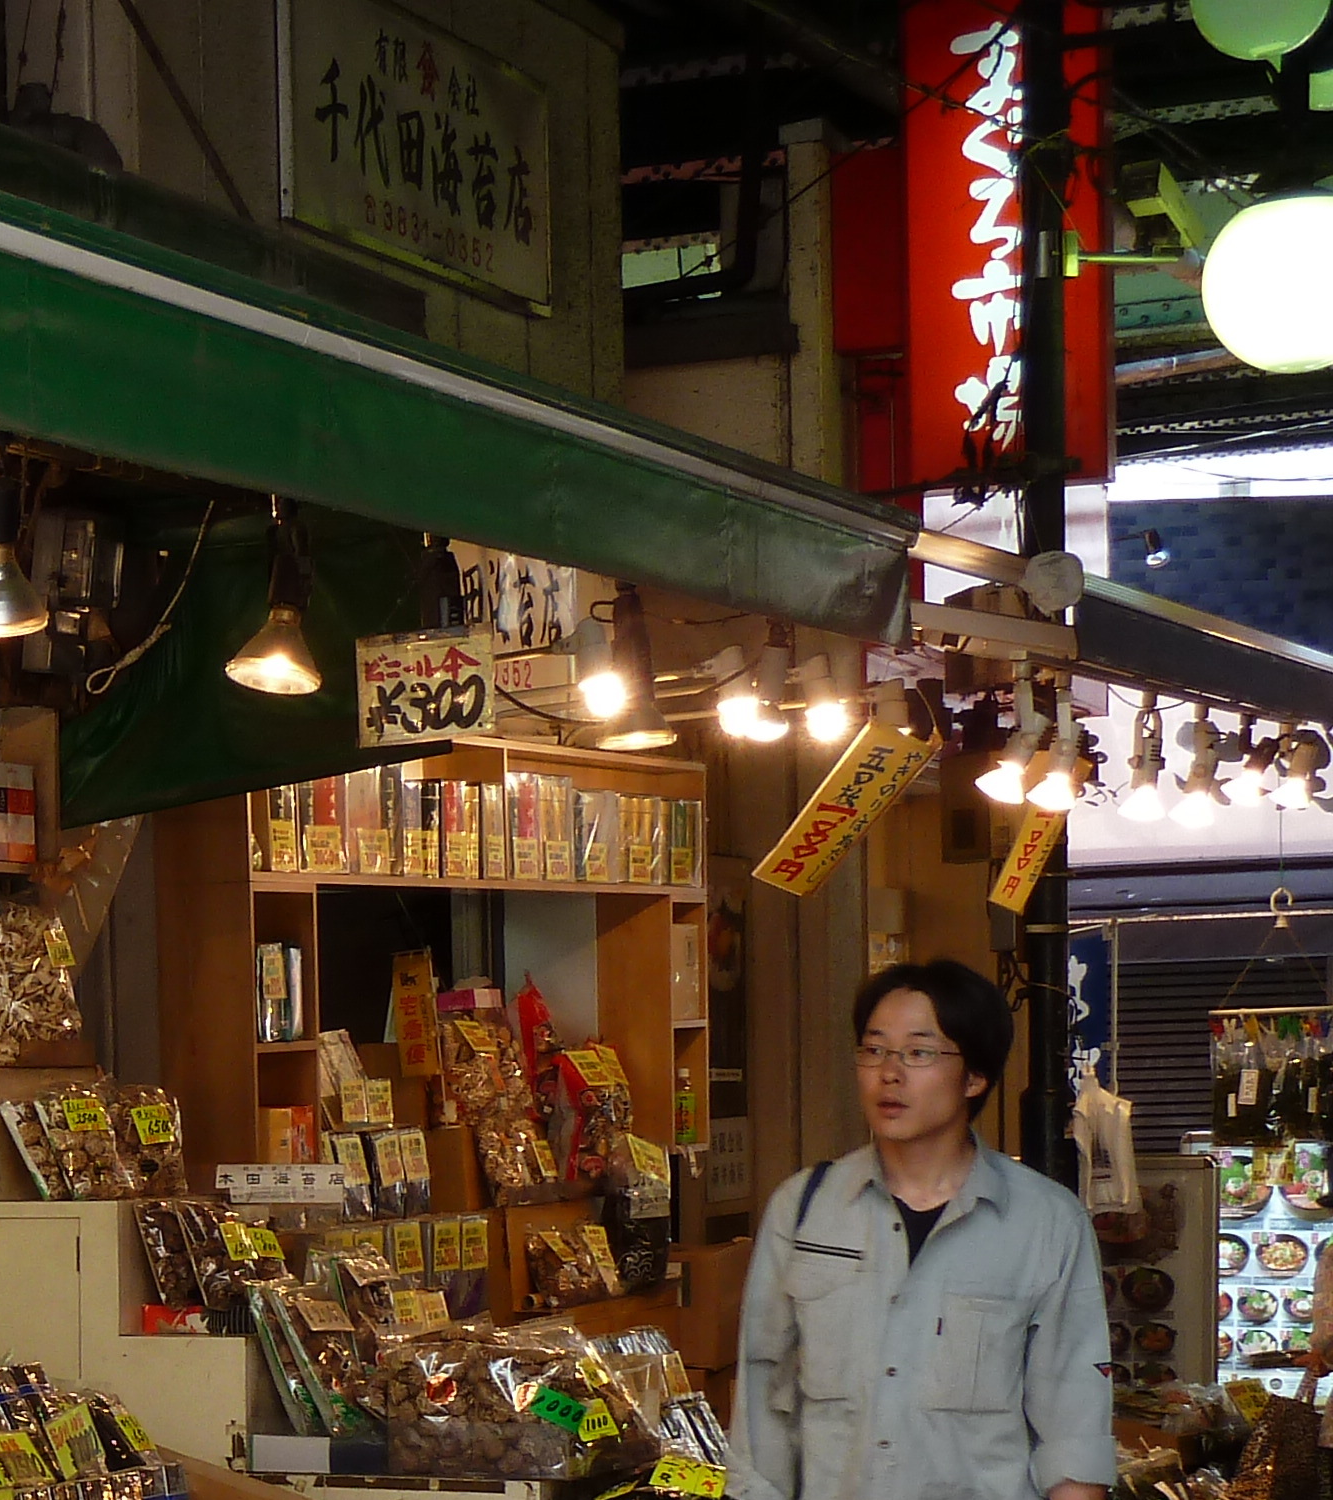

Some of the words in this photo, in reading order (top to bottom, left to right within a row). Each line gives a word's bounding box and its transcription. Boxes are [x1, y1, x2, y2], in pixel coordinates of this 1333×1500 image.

[314, 57, 532, 247] 千代田海苔店
